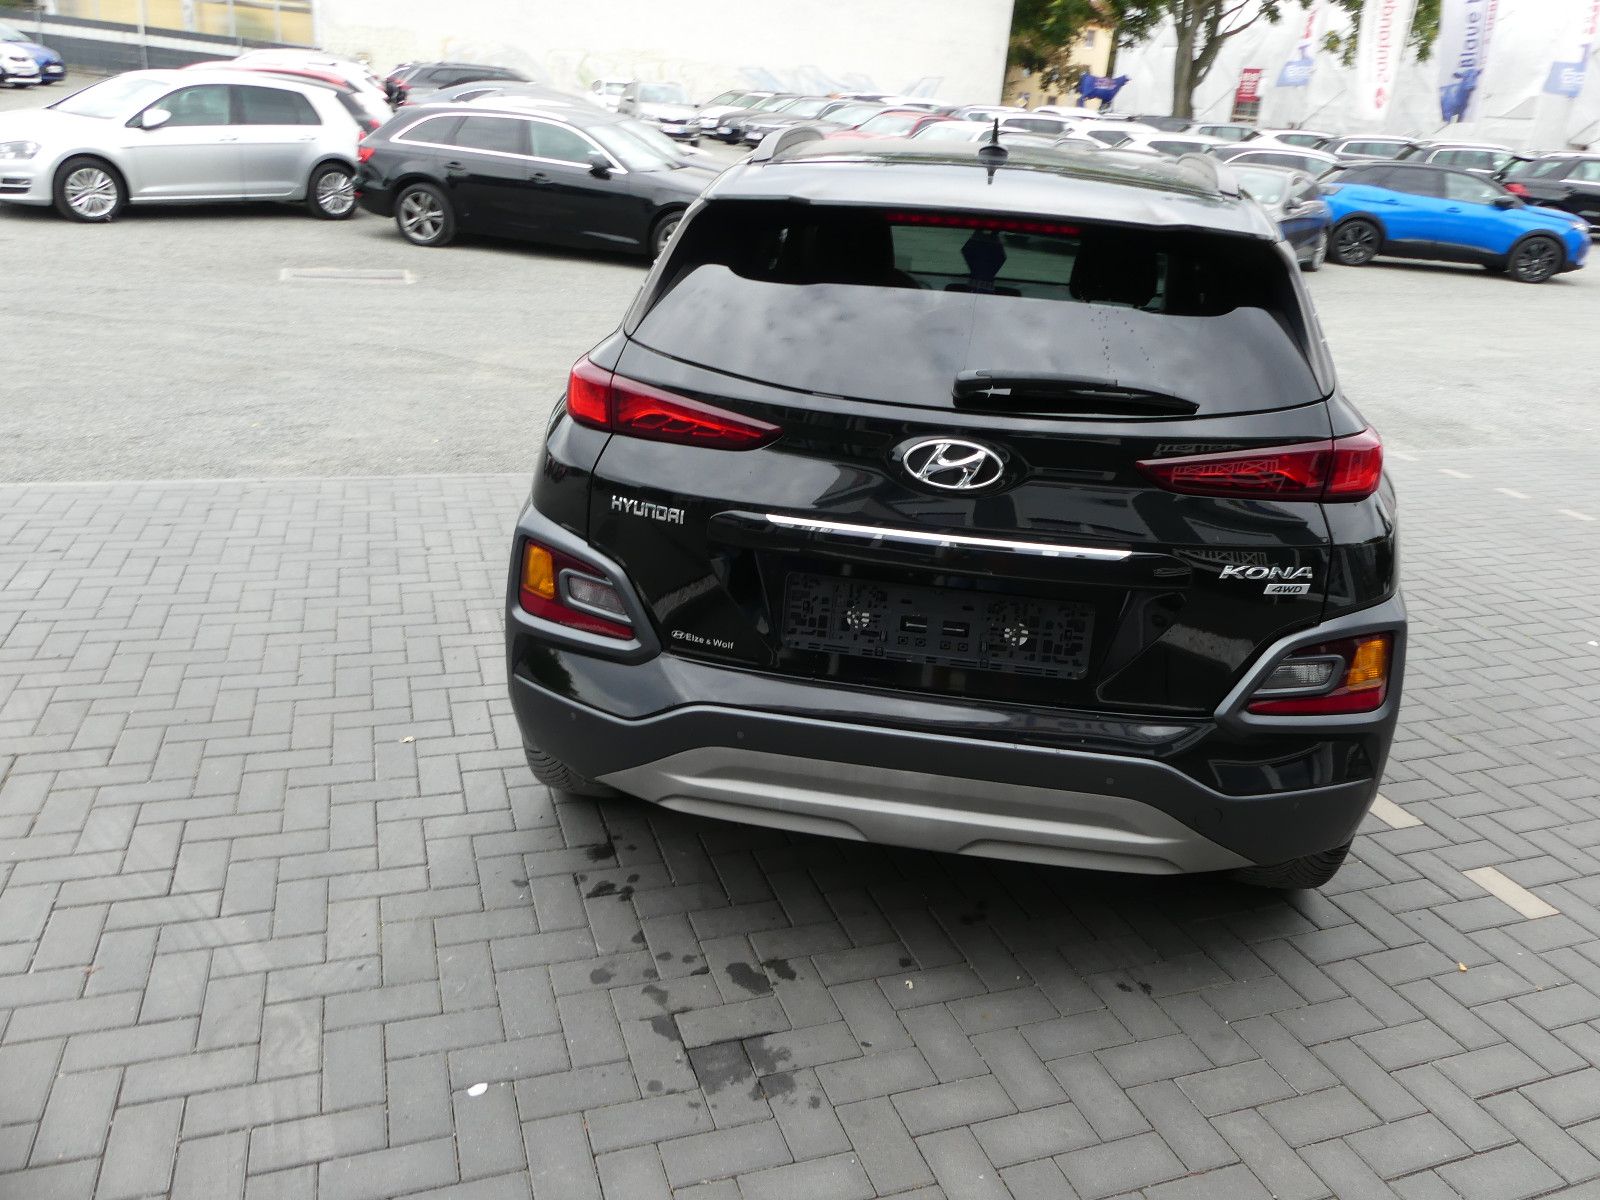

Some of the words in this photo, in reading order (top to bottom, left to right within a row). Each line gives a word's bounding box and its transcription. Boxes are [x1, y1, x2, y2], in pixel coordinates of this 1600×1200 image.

[611, 495, 685, 524] HYUNDAI
[1219, 565, 1313, 579] KONA
[1272, 585, 1302, 593] 4WD
[685, 632, 704, 644] Elze
[713, 638, 734, 650] Wolf
